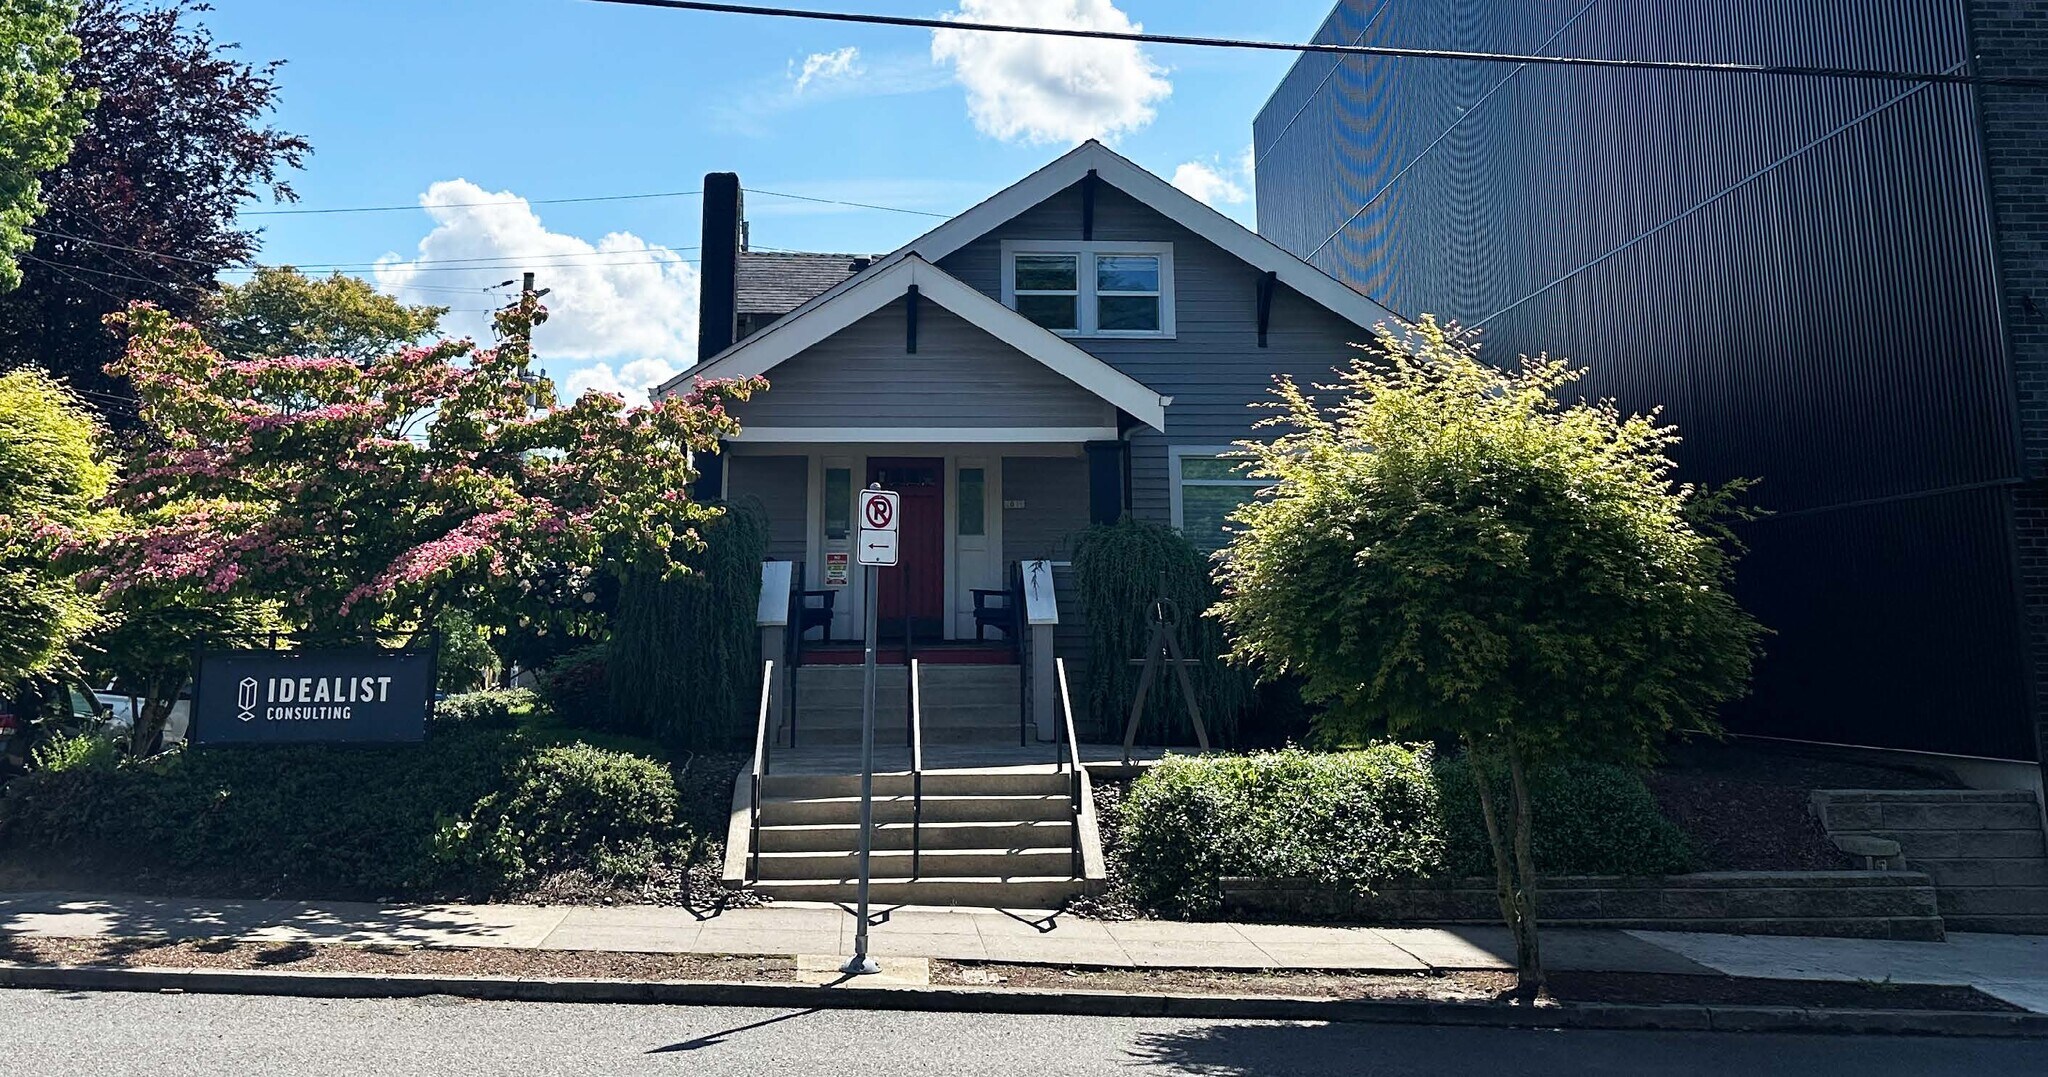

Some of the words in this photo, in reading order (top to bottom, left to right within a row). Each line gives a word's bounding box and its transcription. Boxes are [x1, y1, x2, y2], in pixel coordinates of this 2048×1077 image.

[873, 500, 887, 521] P
[267, 676, 392, 703] IDEALIST
[266, 706, 351, 720] CONSULTING
